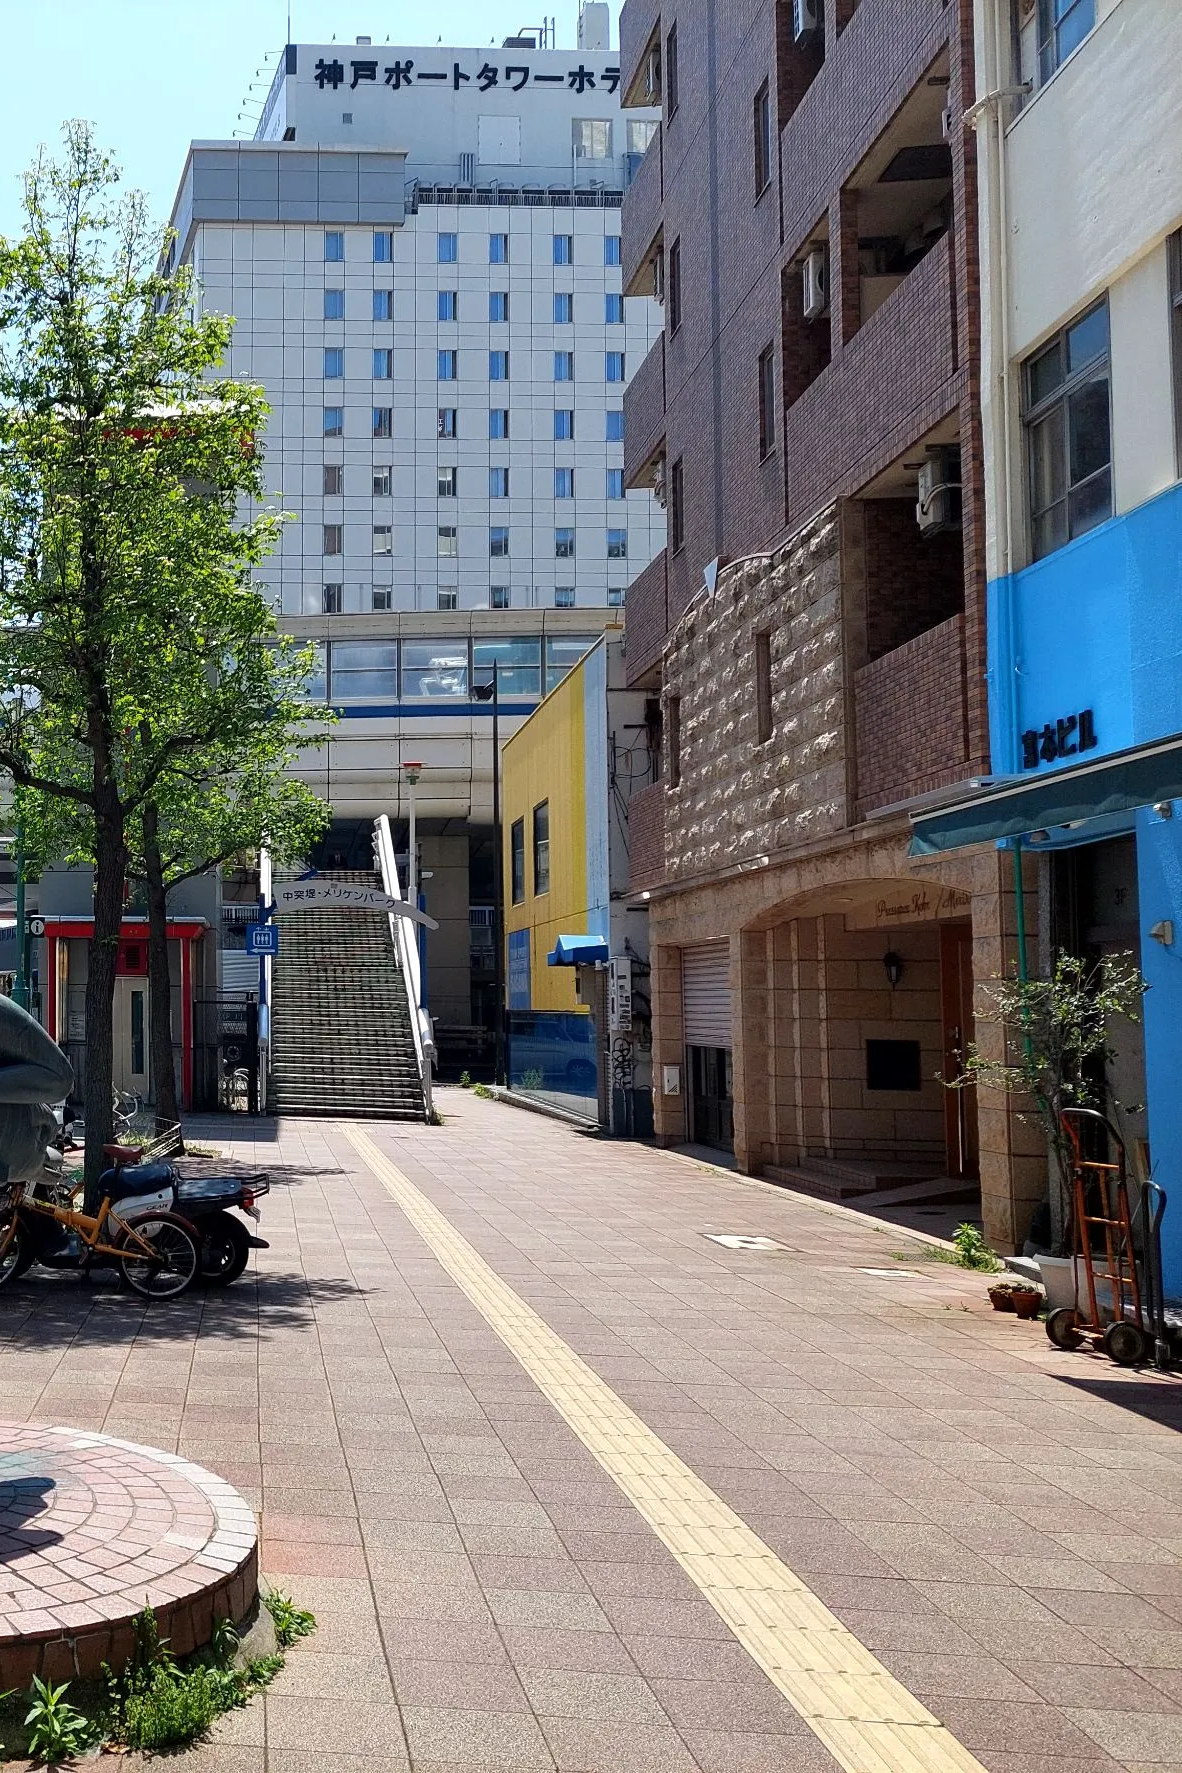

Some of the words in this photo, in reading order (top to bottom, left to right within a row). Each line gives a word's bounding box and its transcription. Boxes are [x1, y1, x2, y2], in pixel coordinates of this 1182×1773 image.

[314, 58, 620, 94] 神戸ポートタワーホテ
[282, 888, 396, 909] 中突堤・メリケンパーク
